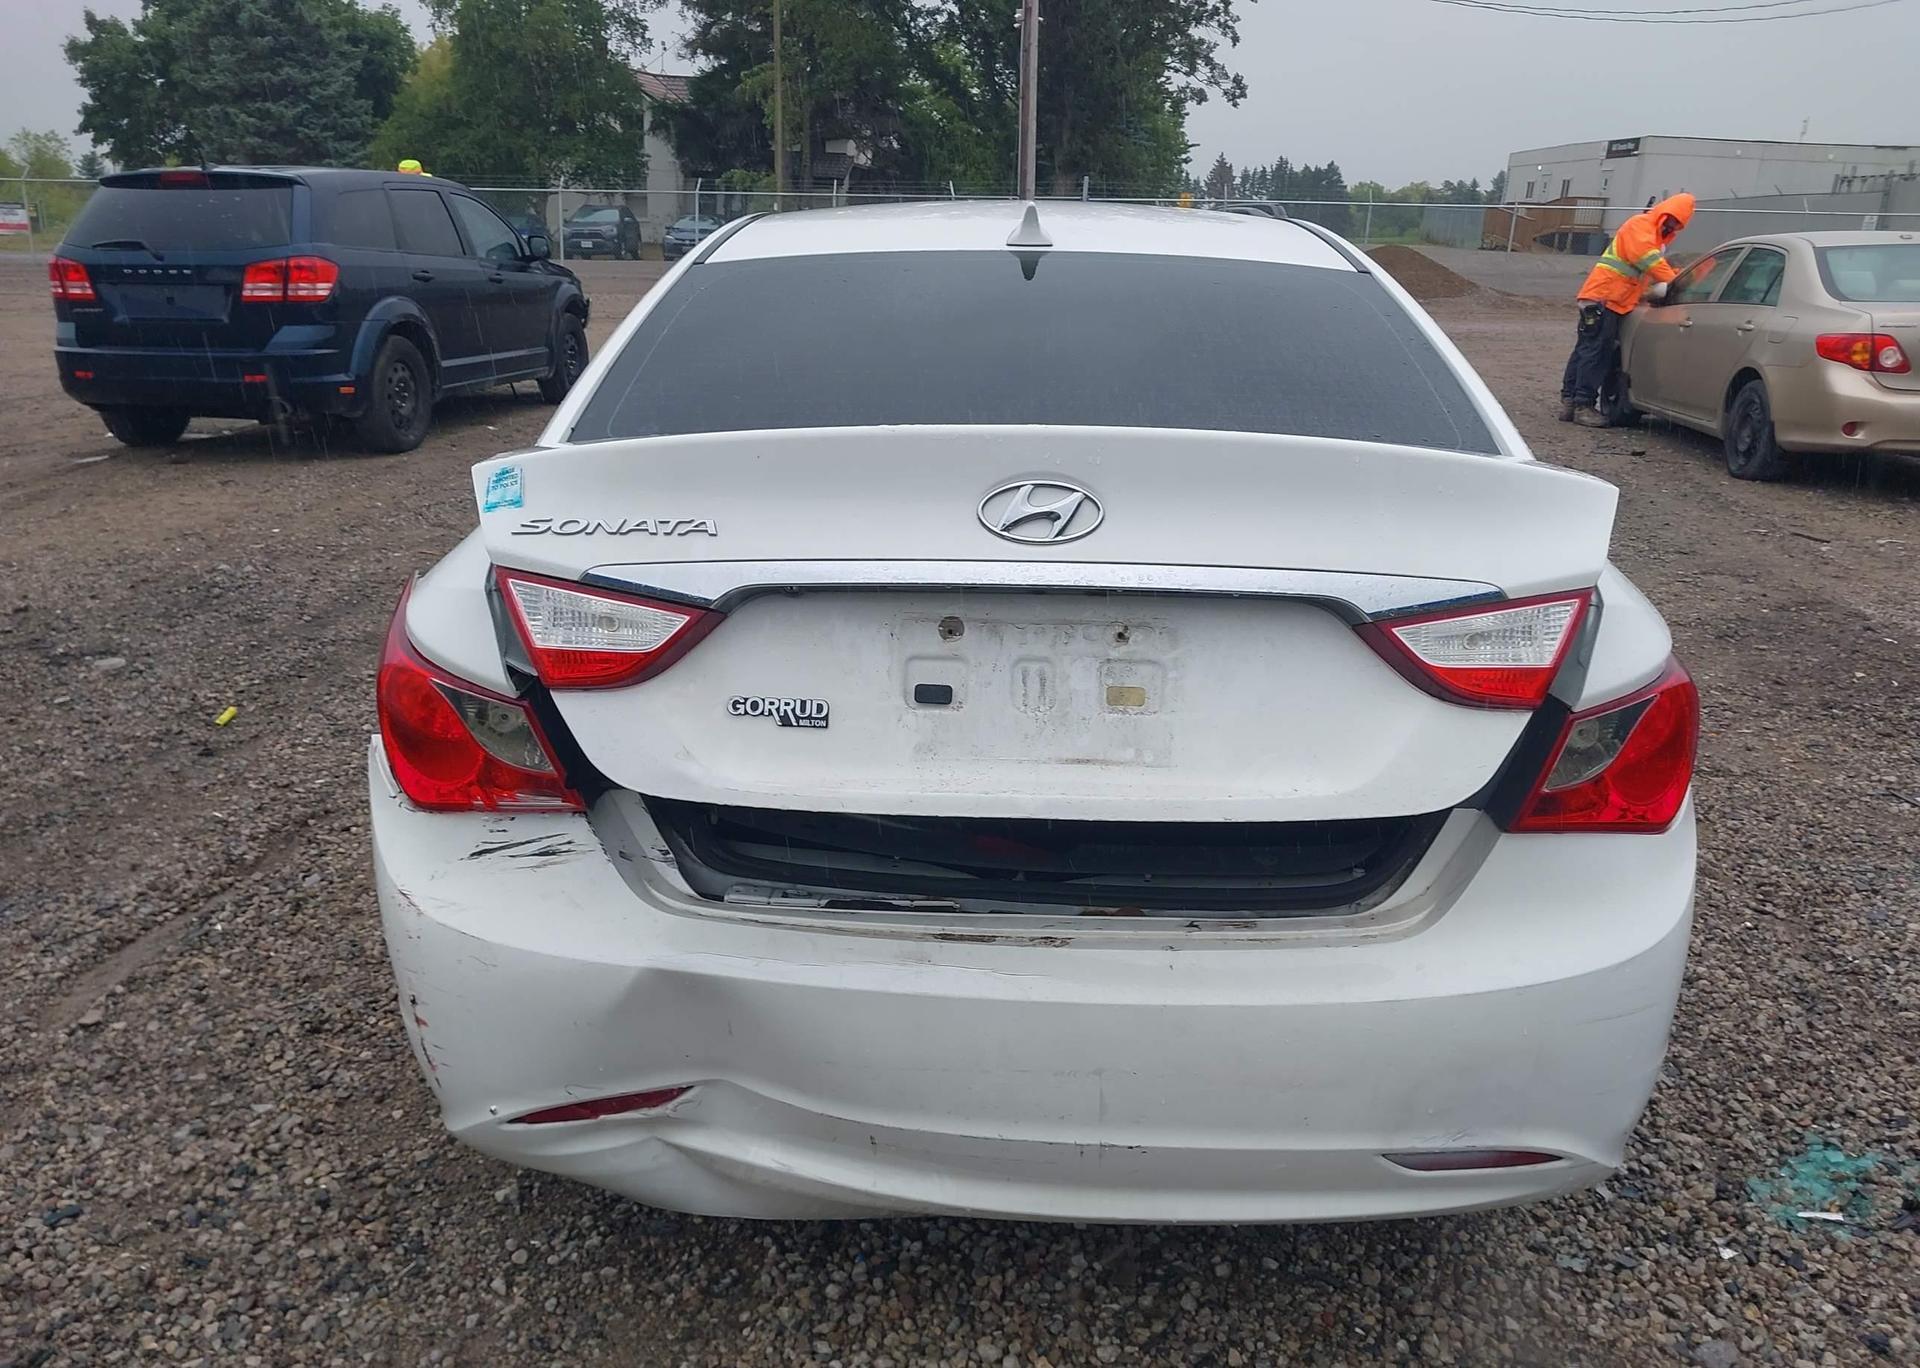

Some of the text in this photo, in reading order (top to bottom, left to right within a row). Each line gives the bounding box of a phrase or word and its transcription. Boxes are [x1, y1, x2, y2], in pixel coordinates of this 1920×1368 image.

[511, 517, 718, 537] SONATA
[727, 696, 829, 726] GORRUD
[798, 719, 827, 727] MILTON
